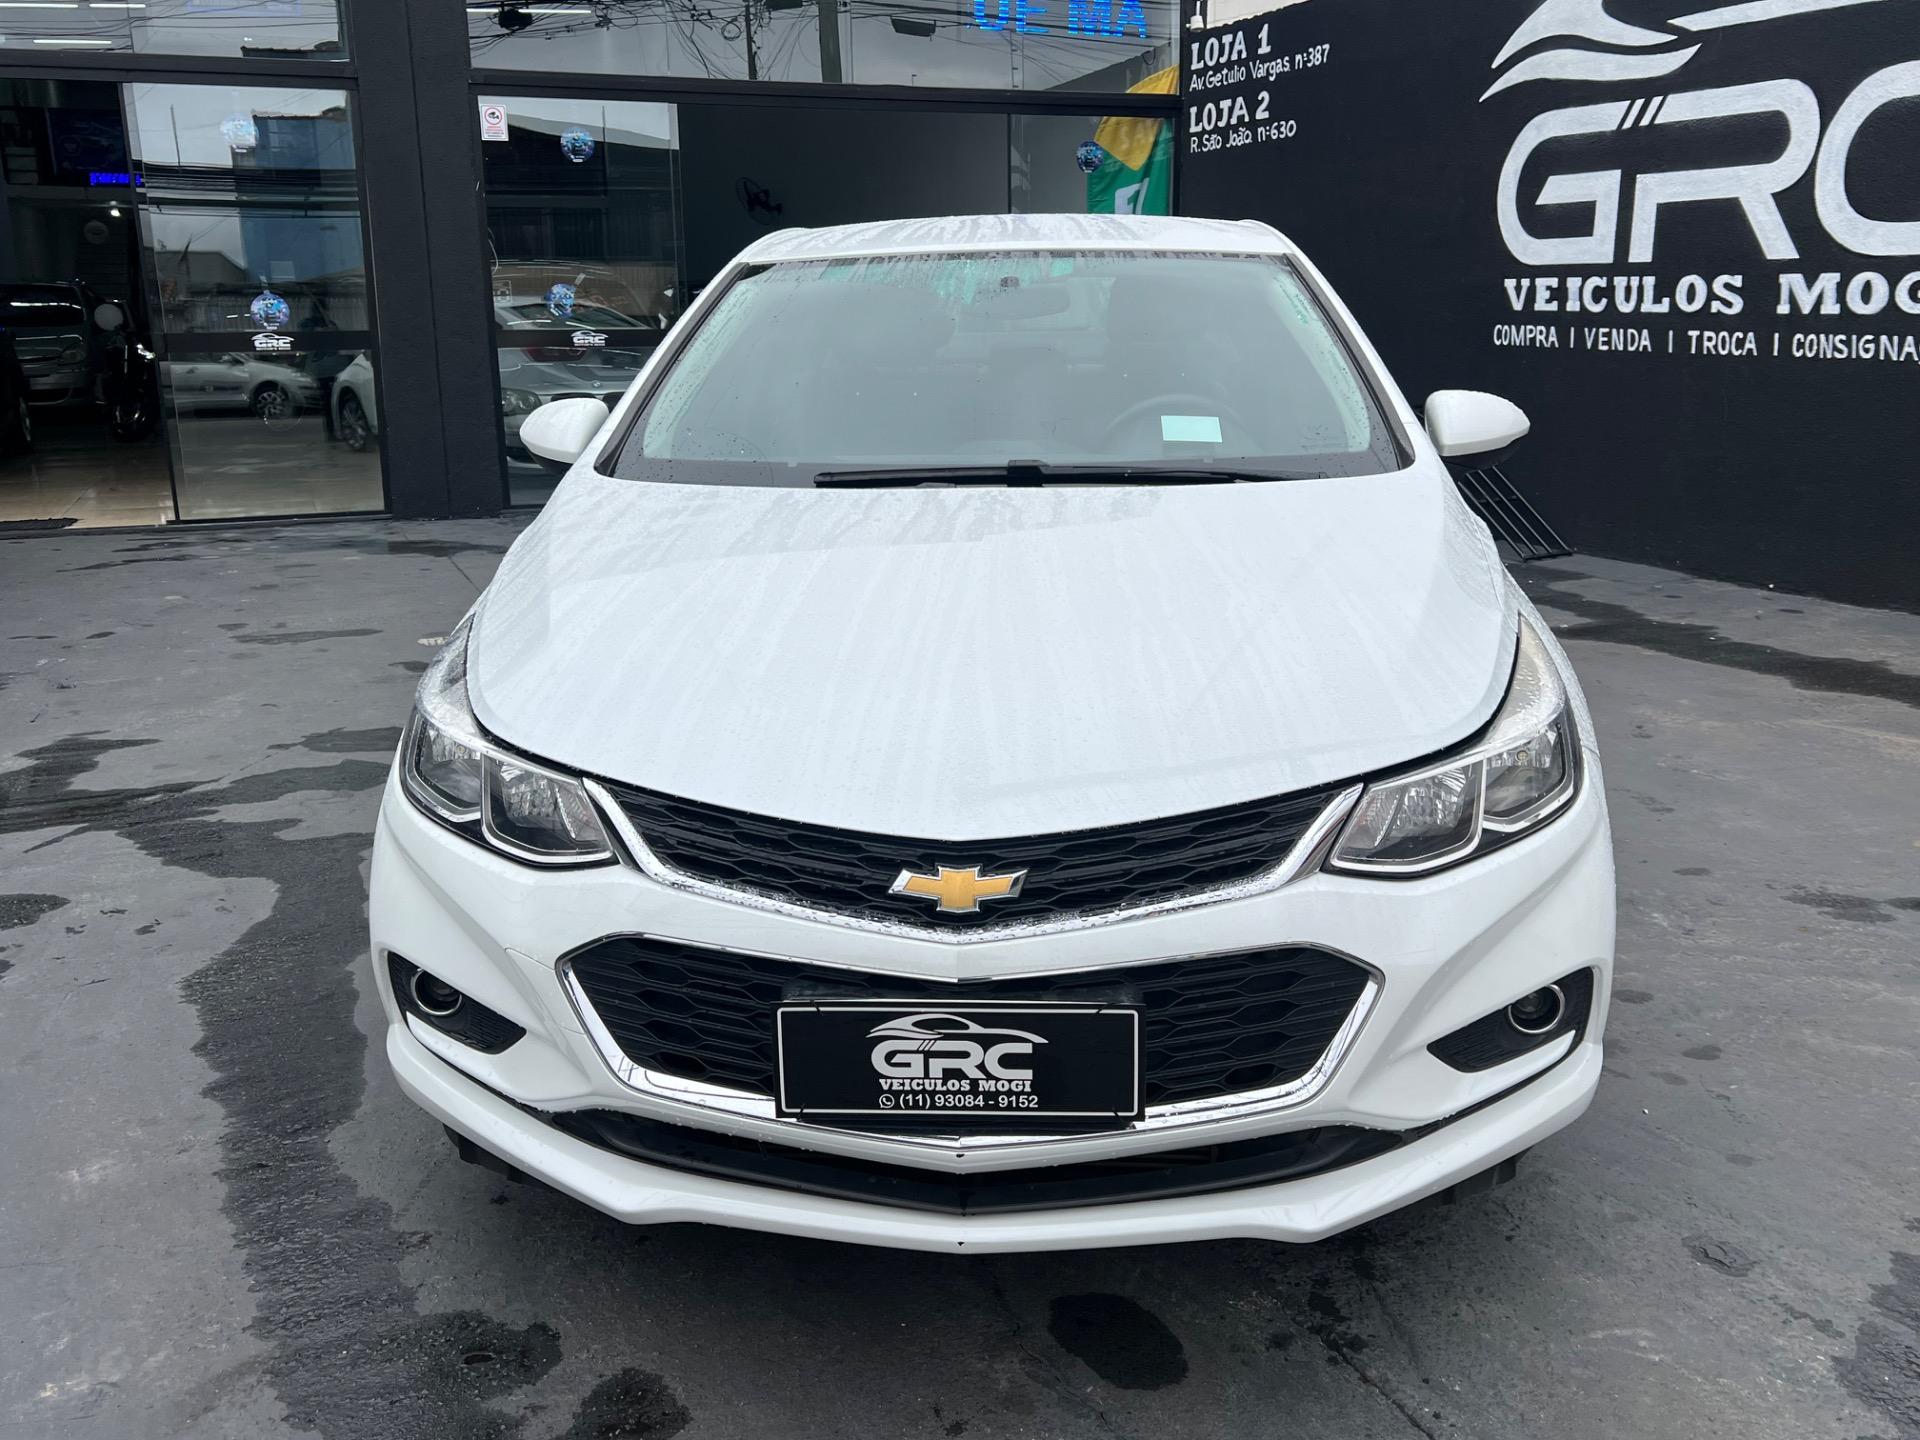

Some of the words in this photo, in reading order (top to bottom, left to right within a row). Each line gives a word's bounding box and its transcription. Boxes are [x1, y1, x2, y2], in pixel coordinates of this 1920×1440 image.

[1190, 31, 1248, 71] LOJA
[1257, 23, 1272, 55] 1
[1189, 96, 1250, 134] LOJA
[1255, 90, 1271, 120] 2
[1496, 59, 1920, 267] GRC
[1503, 274, 1745, 316] VEICULOS
[1493, 323, 1559, 348] COMPRA
[1584, 327, 1652, 353] VENDA
[1687, 330, 1758, 357] TROCA
[1791, 333, 1920, 364] CONSIGNA
[871, 1039, 1033, 1080] GRC
[878, 1078, 971, 1092] VEICULOS
[978, 1079, 1032, 1093] MOGI
[899, 1093, 931, 1109] (11)
[934, 1093, 985, 1108] 93084
[998, 1095, 1039, 1108] 9152
